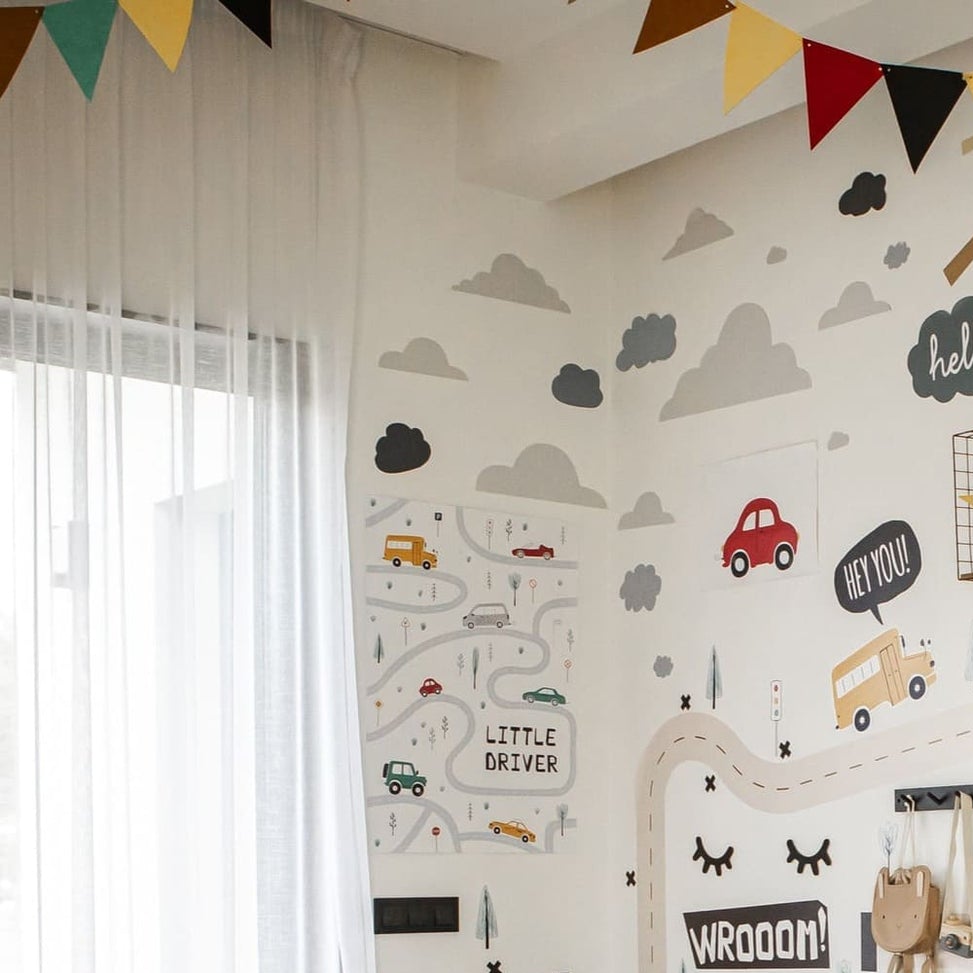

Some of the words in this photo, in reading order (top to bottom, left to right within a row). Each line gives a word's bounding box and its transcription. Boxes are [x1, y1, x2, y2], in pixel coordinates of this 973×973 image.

[843, 556, 874, 600] HEY
[870, 534, 911, 587] YOU!
[485, 725, 557, 746] LITTLE
[485, 752, 559, 773] DRIVER
[688, 906, 828, 965] WROOOM!
